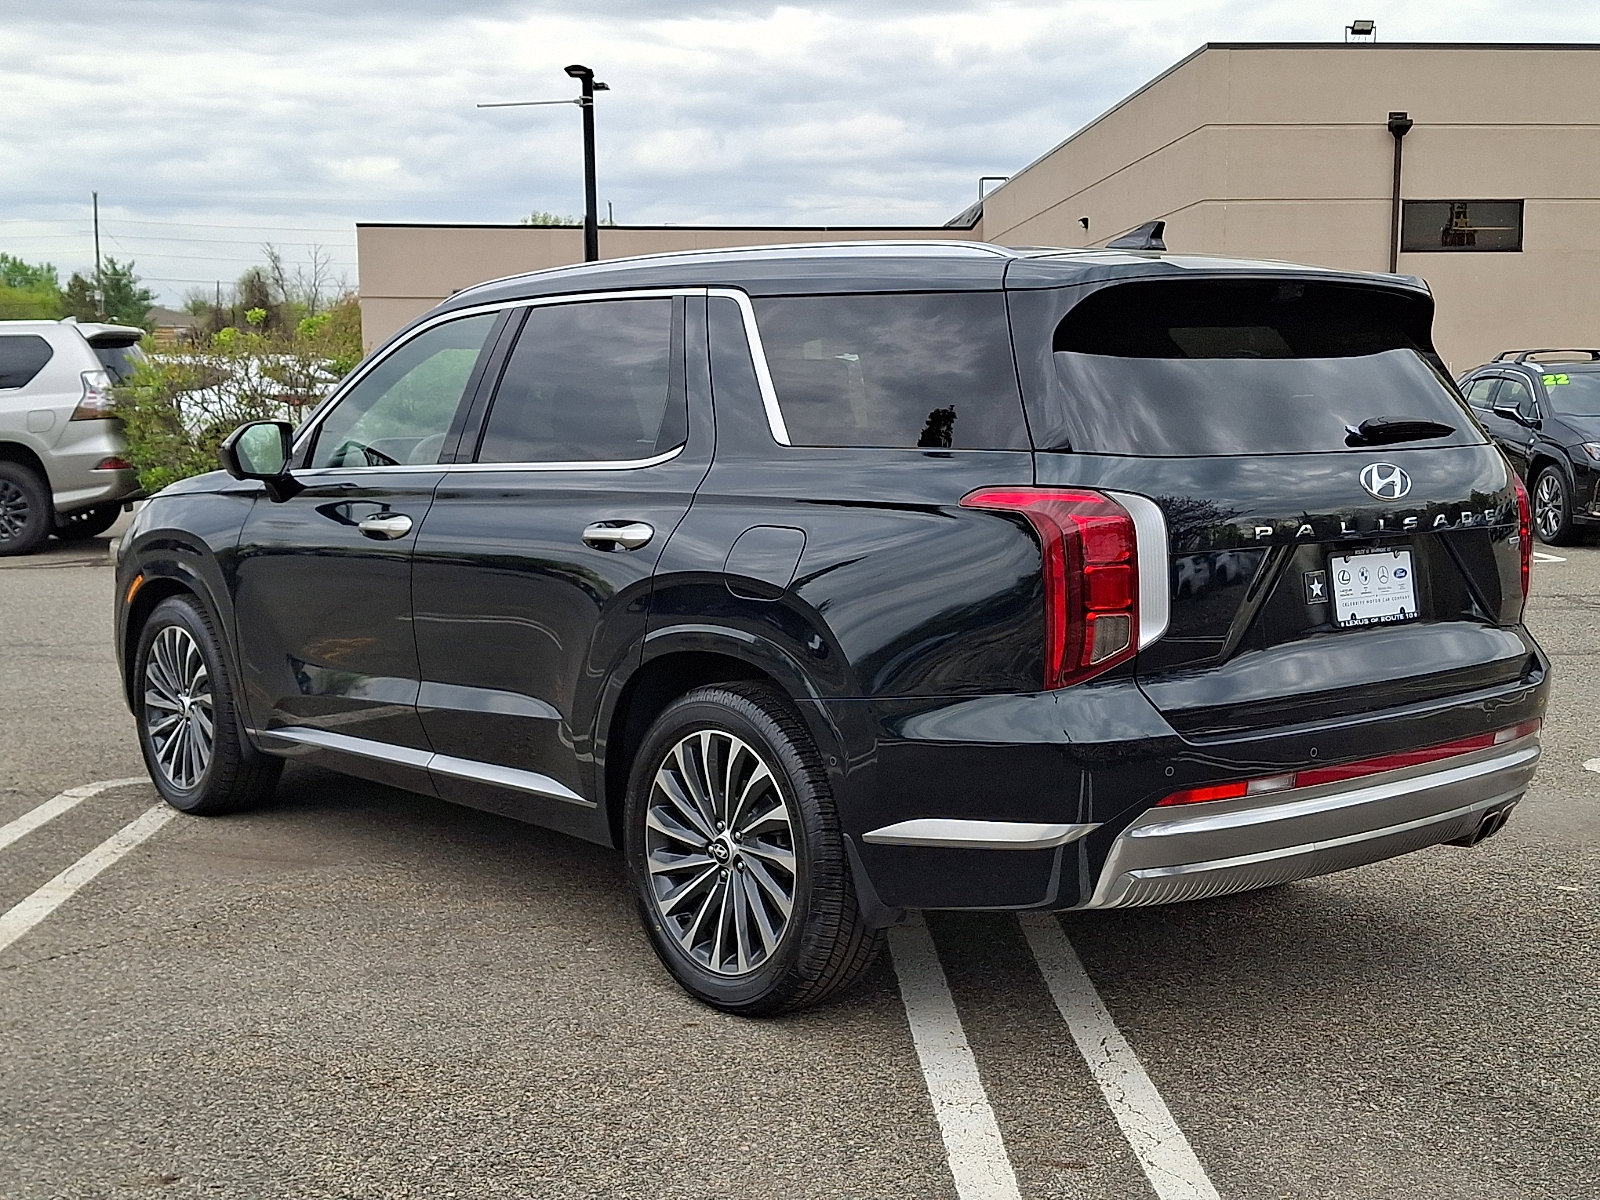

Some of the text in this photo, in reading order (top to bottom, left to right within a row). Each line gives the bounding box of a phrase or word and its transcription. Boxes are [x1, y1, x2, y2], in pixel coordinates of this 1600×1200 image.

[1542, 373, 1570, 386] 22
[1254, 509, 1495, 540] PALISADE
[1345, 619, 1369, 627] LEXUS
[1380, 613, 1405, 622] ROUTE
